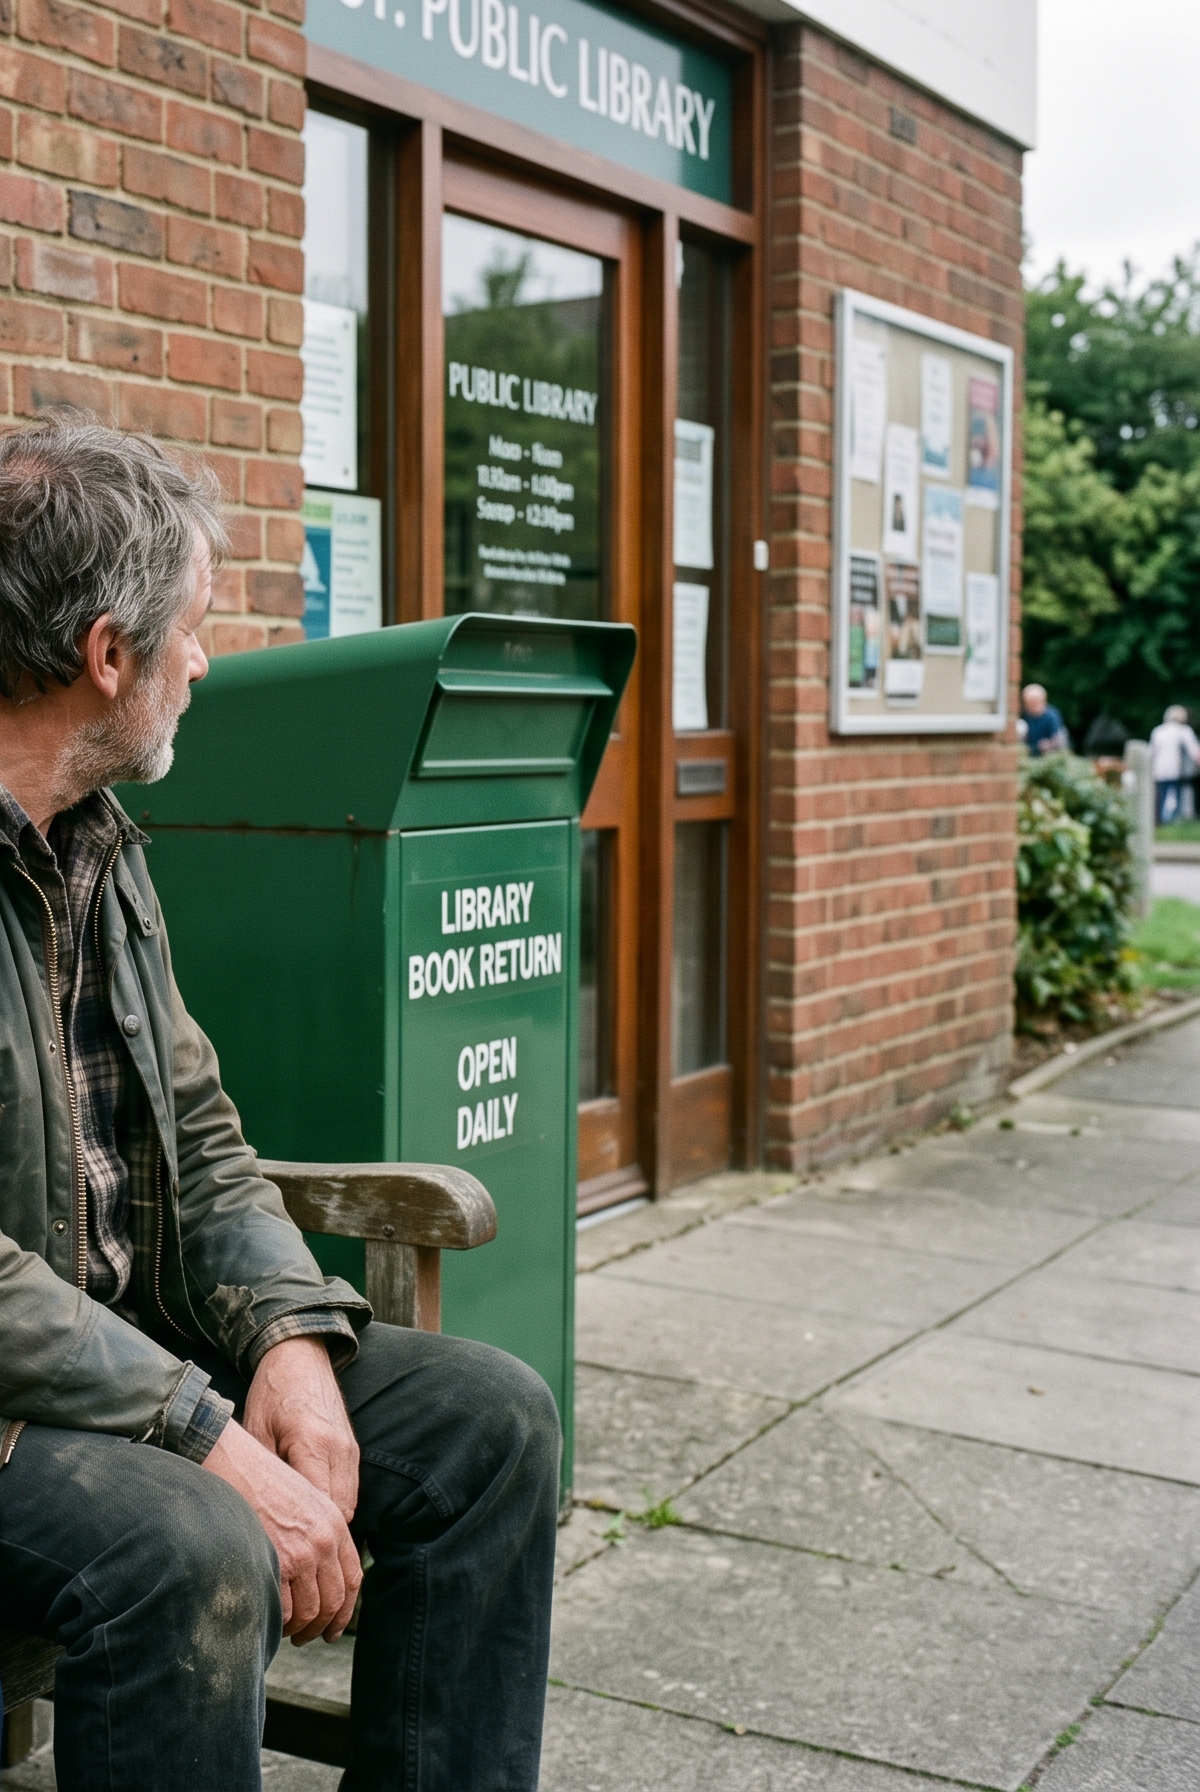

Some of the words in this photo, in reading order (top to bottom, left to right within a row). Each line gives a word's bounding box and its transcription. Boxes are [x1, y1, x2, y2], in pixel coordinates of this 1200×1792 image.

[422, 0, 568, 98] PUBLIC
[579, 38, 715, 160] LIBRARY
[449, 361, 520, 410] PUBLIC
[523, 378, 598, 426] LIBRARY
[441, 881, 534, 935] LIBRARY
[409, 946, 476, 1000] BOOK
[479, 932, 562, 987] RETURN
[458, 1036, 517, 1092] OPEN
[457, 1092, 519, 1151] DAILY
